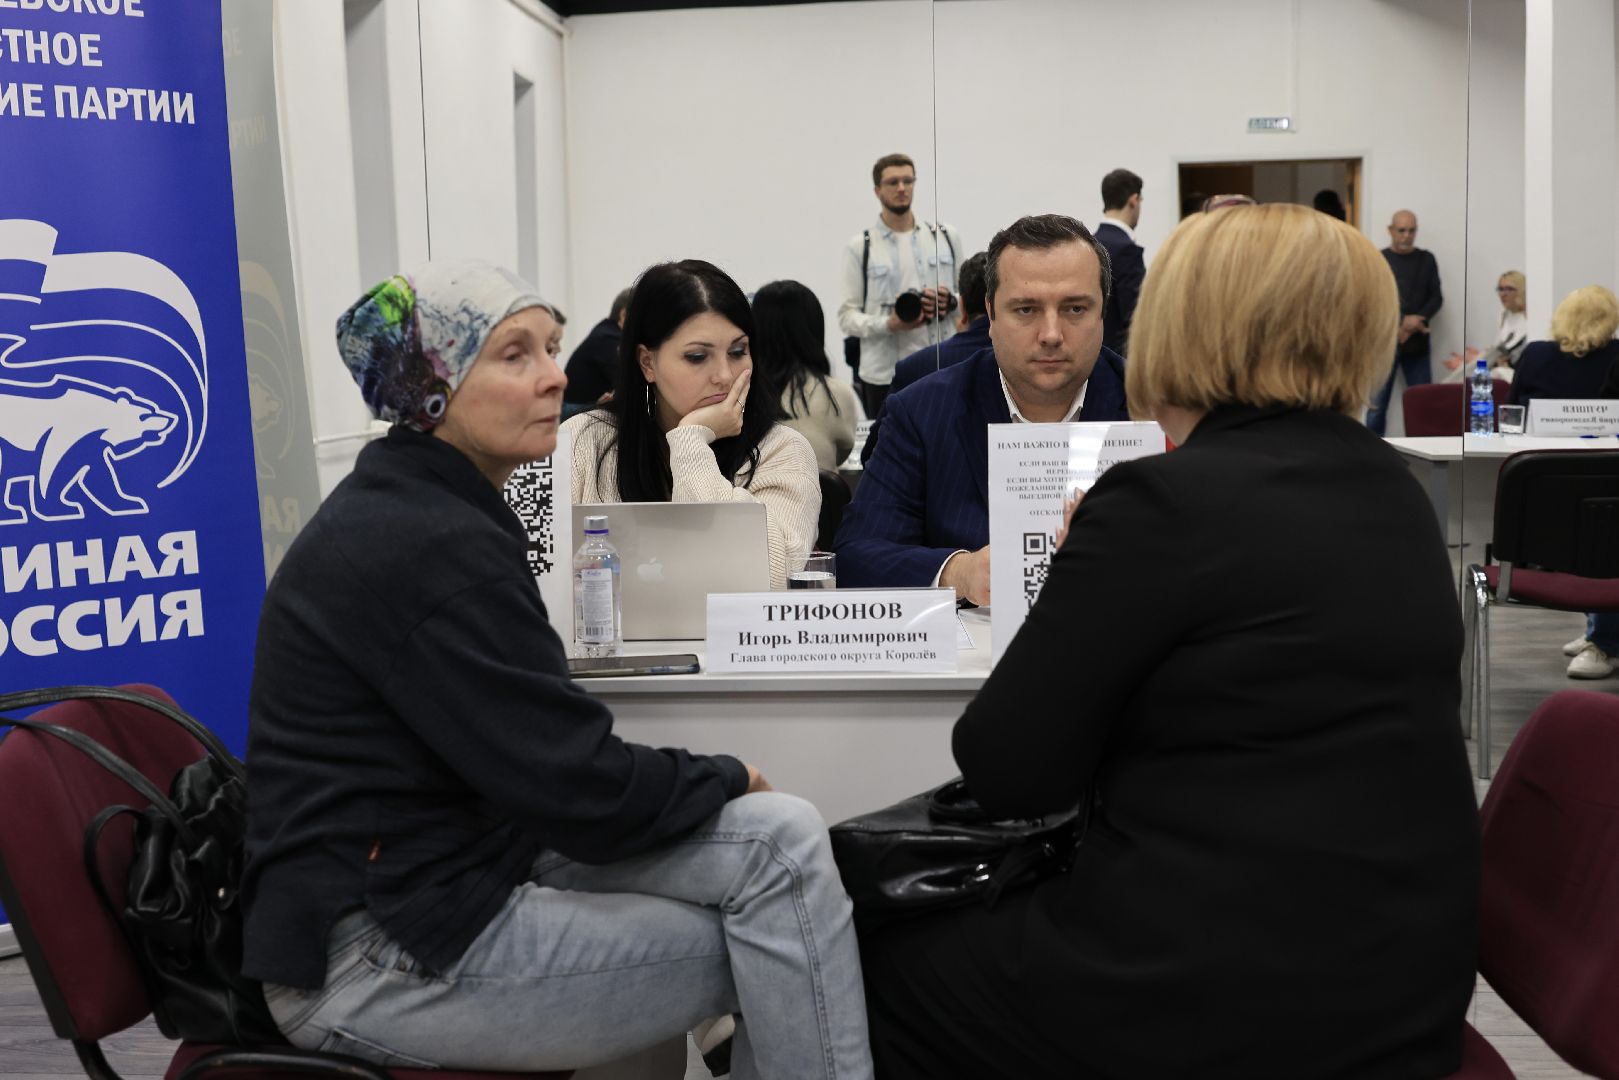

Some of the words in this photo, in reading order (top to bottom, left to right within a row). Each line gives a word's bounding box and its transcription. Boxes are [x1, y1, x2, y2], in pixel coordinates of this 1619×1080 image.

[0, 28, 103, 67] ТНОЕ
[54, 84, 195, 125] ПАРТИИ
[997, 442, 1021, 450] НАМ
[1023, 440, 1061, 450] ВАЖНО
[1103, 439, 1143, 448] НЕНИЕ!
[1, 530, 199, 593] ИНАЯ
[0, 588, 205, 657] ССИЯ
[762, 602, 903, 622] ТРИФОНОВ
[738, 631, 792, 648] Игорь
[798, 630, 928, 646] Владимирович
[731, 653, 766, 663] Глава
[770, 653, 837, 664] городского
[840, 652, 881, 663] округа
[885, 650, 936, 662] Королёв
